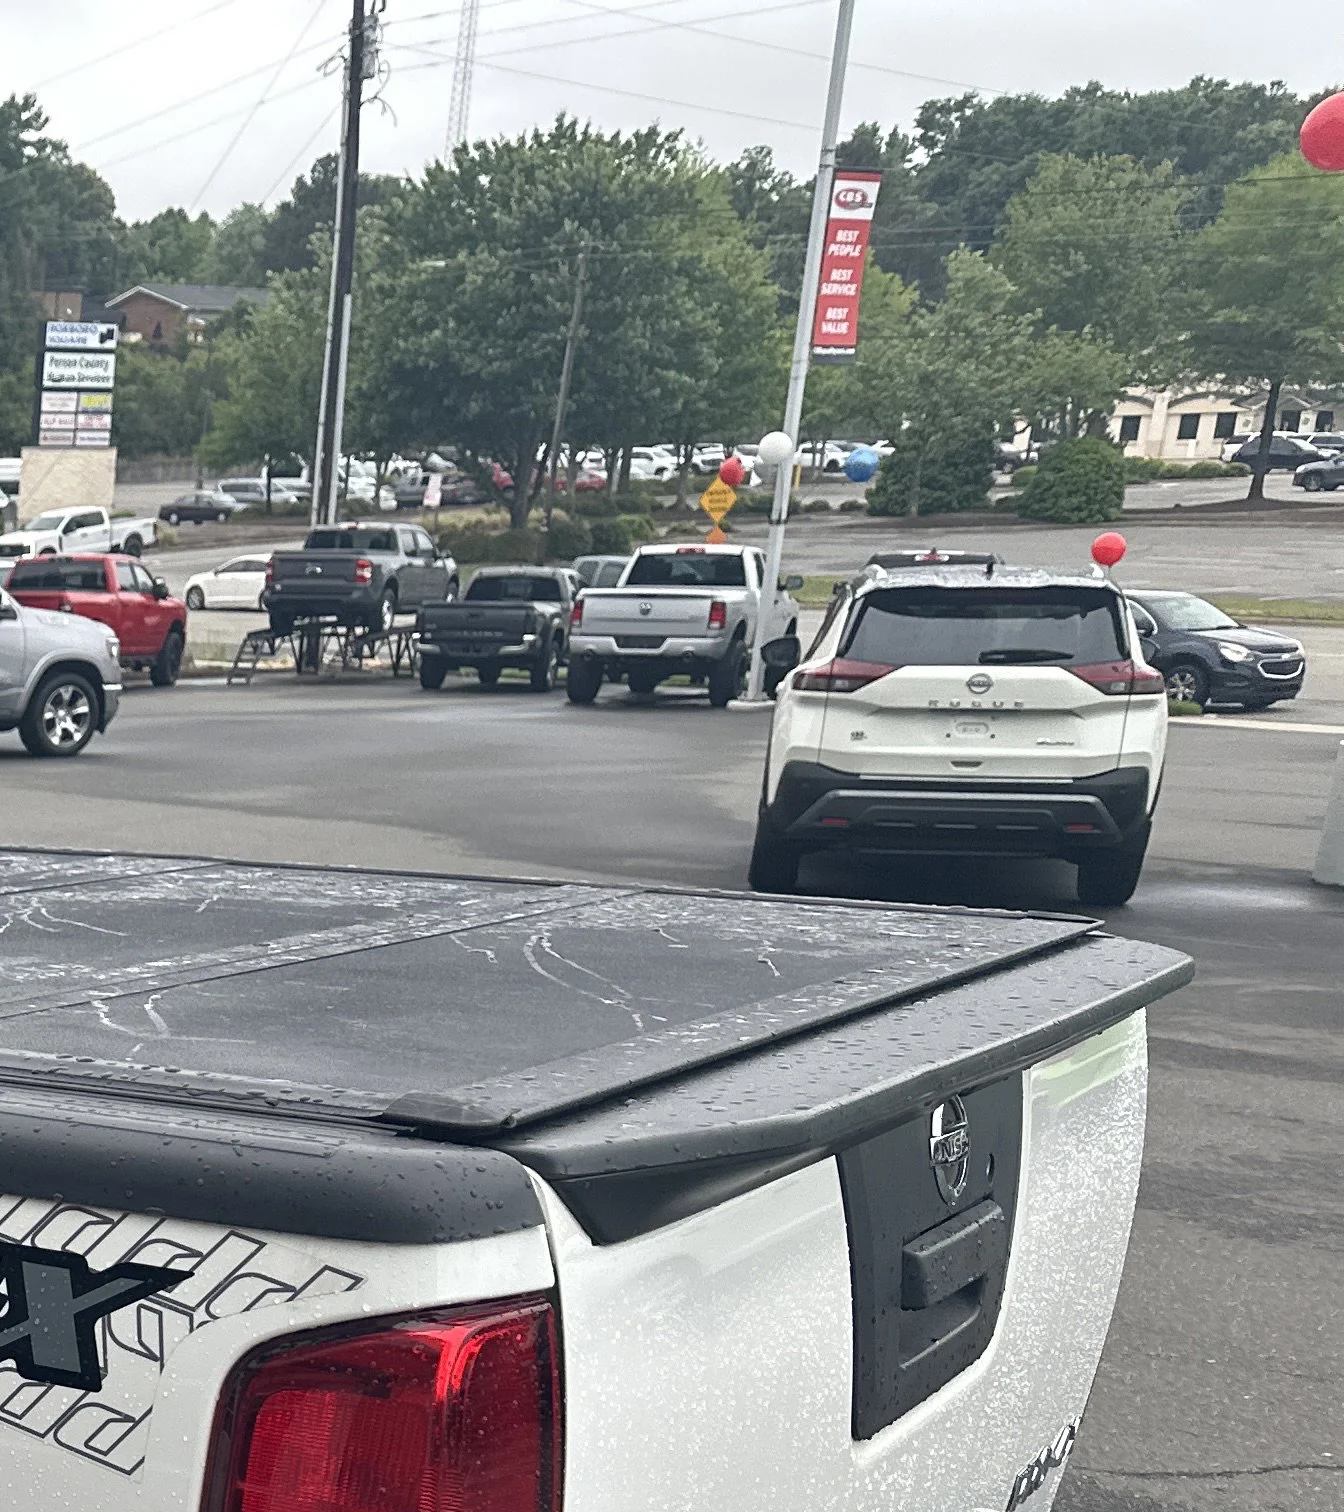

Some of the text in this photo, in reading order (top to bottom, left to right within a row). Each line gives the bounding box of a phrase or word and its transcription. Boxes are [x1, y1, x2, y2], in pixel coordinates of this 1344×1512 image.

[836, 229, 860, 242] BEST
[827, 243, 862, 257] PEOPLE
[830, 268, 853, 281] BEST
[820, 282, 857, 296] SERVICE
[825, 306, 849, 320] BEST
[821, 321, 849, 334] VALUE
